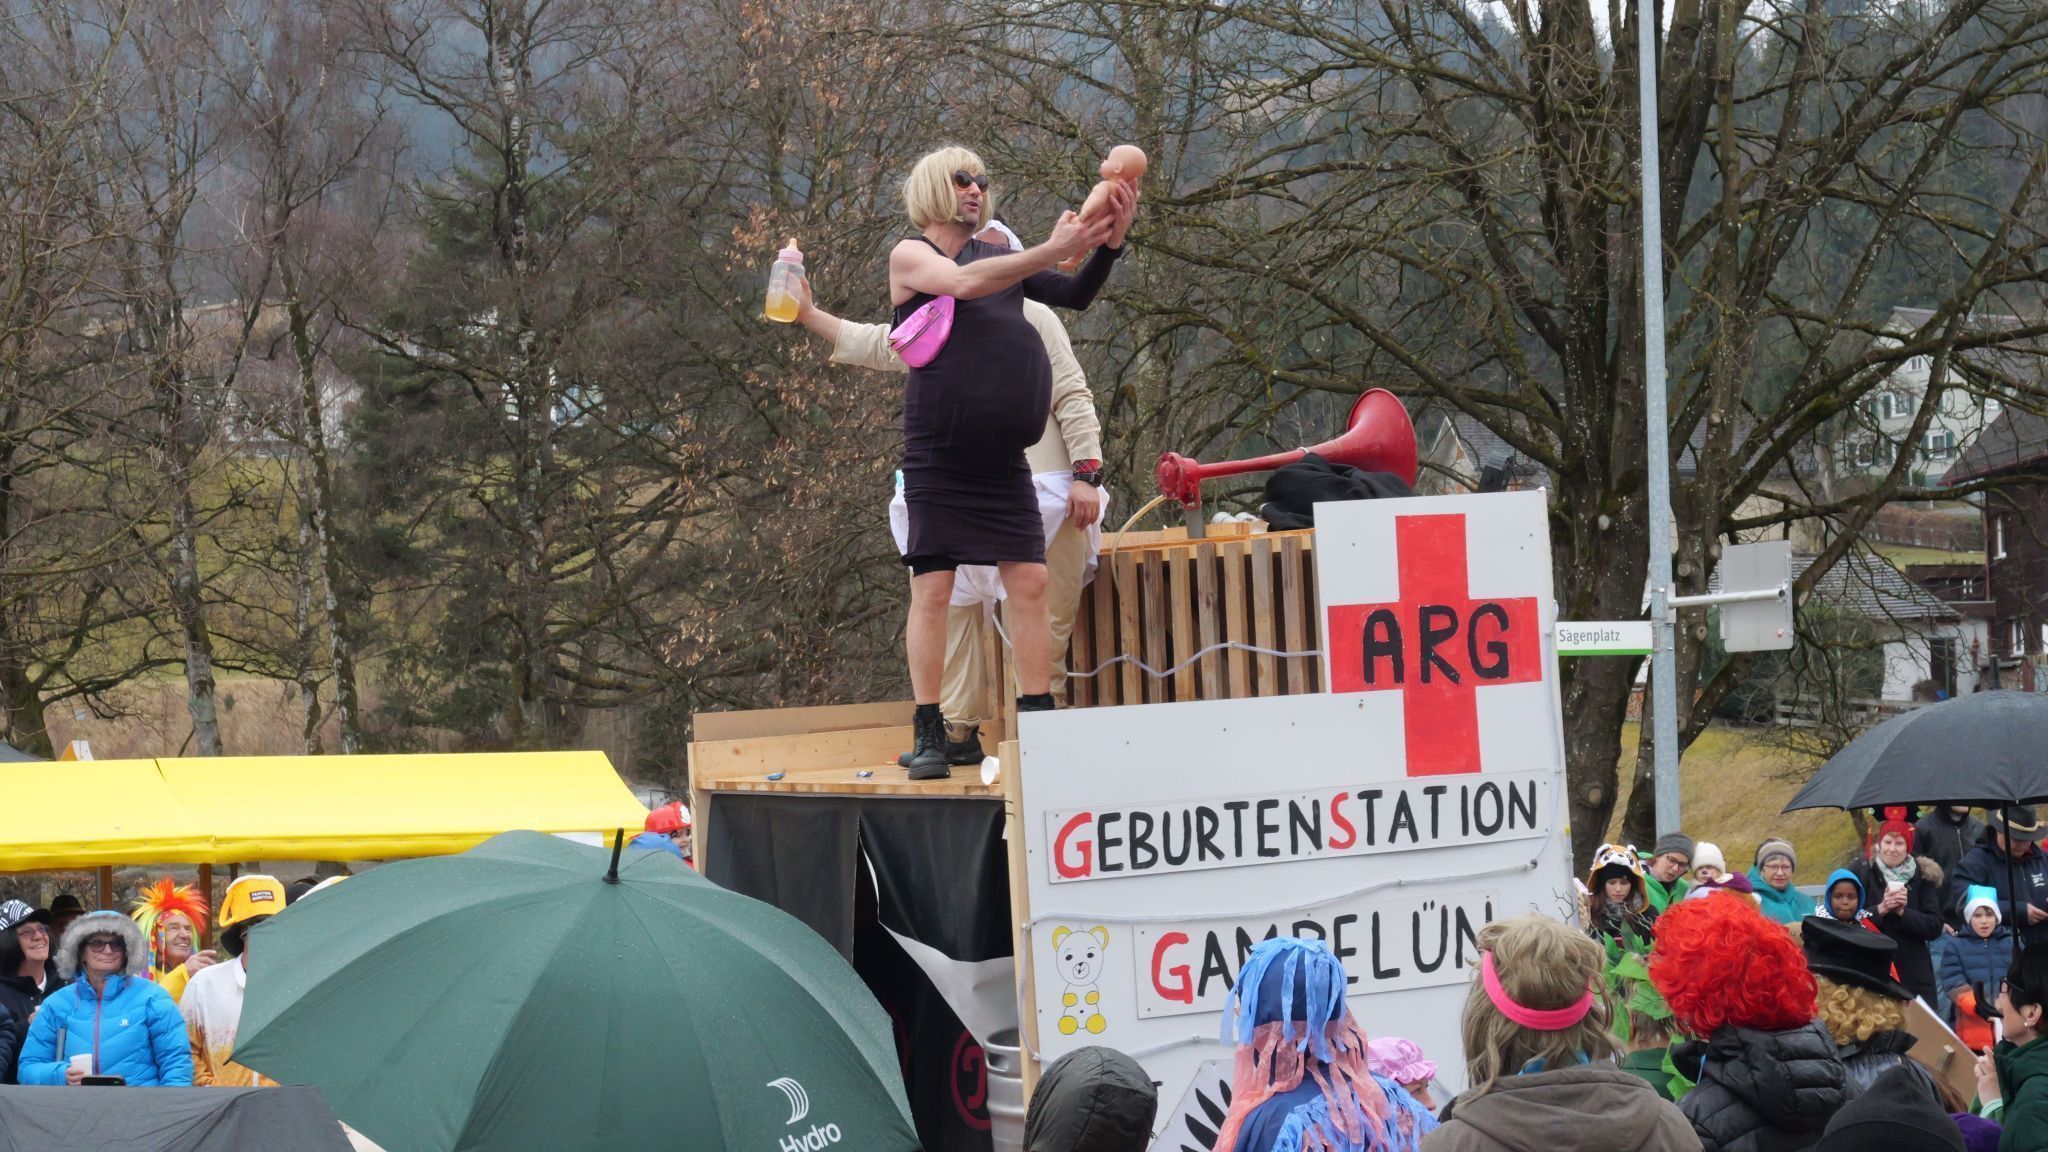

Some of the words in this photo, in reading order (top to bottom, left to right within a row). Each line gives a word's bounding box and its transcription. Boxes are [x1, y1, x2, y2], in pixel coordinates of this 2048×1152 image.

[1362, 602, 1510, 685] ARG
[1053, 779, 1537, 879] GEBURTENSTATION
[778, 1123, 842, 1152] Hydro
